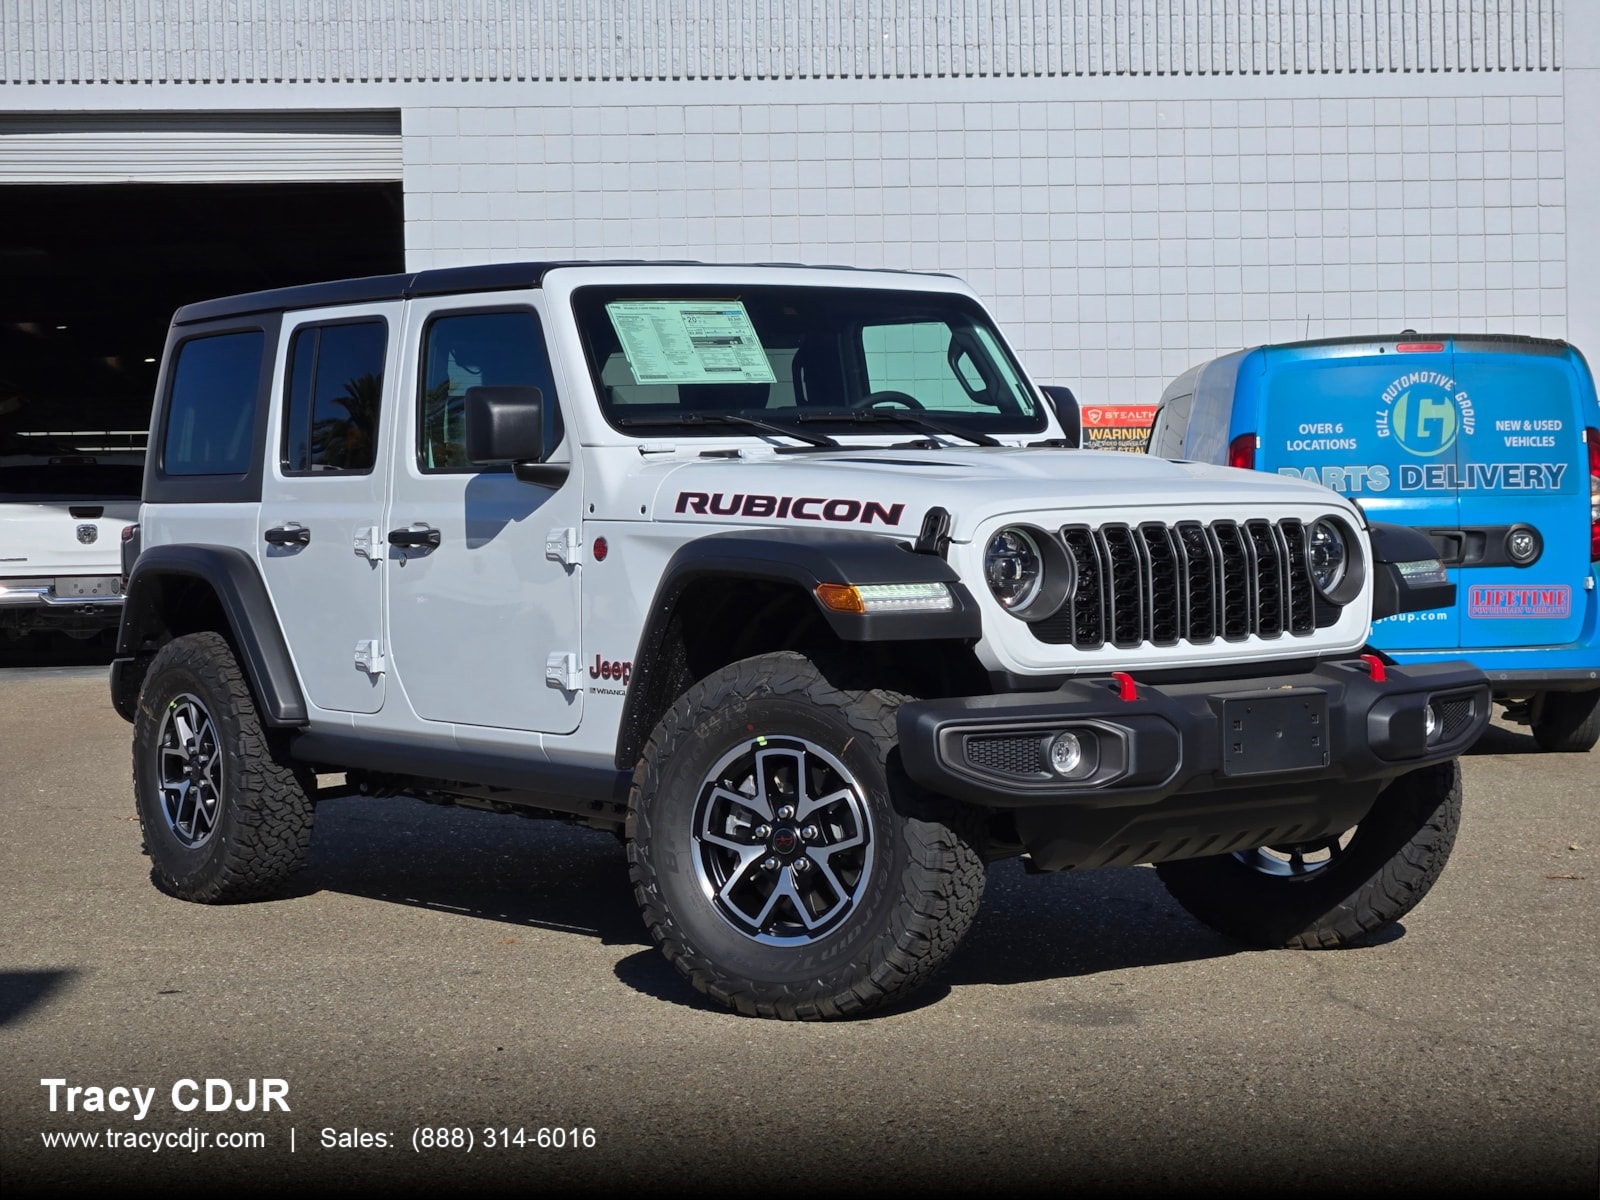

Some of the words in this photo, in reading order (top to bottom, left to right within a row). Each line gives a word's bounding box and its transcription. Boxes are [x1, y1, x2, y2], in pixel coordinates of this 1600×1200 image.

[1382, 371, 1456, 404] AUTOMOTIVE
[1105, 411, 1155, 419] STEALTH
[1376, 409, 1390, 437] GILL
[1455, 391, 1475, 435] GROUP
[1299, 424, 1332, 434] OVER
[1335, 423, 1343, 433] 6
[1496, 420, 1520, 431] NEW
[1523, 420, 1531, 430] &
[1534, 420, 1562, 430] USED
[1287, 439, 1357, 451] LOCATIONS
[1504, 436, 1555, 447] VEHICLES
[1400, 463, 1568, 490] DELIVERY
[675, 492, 905, 526] RUBICON
[1474, 590, 1568, 606] LIFETIME
[589, 654, 631, 686] Jeep
